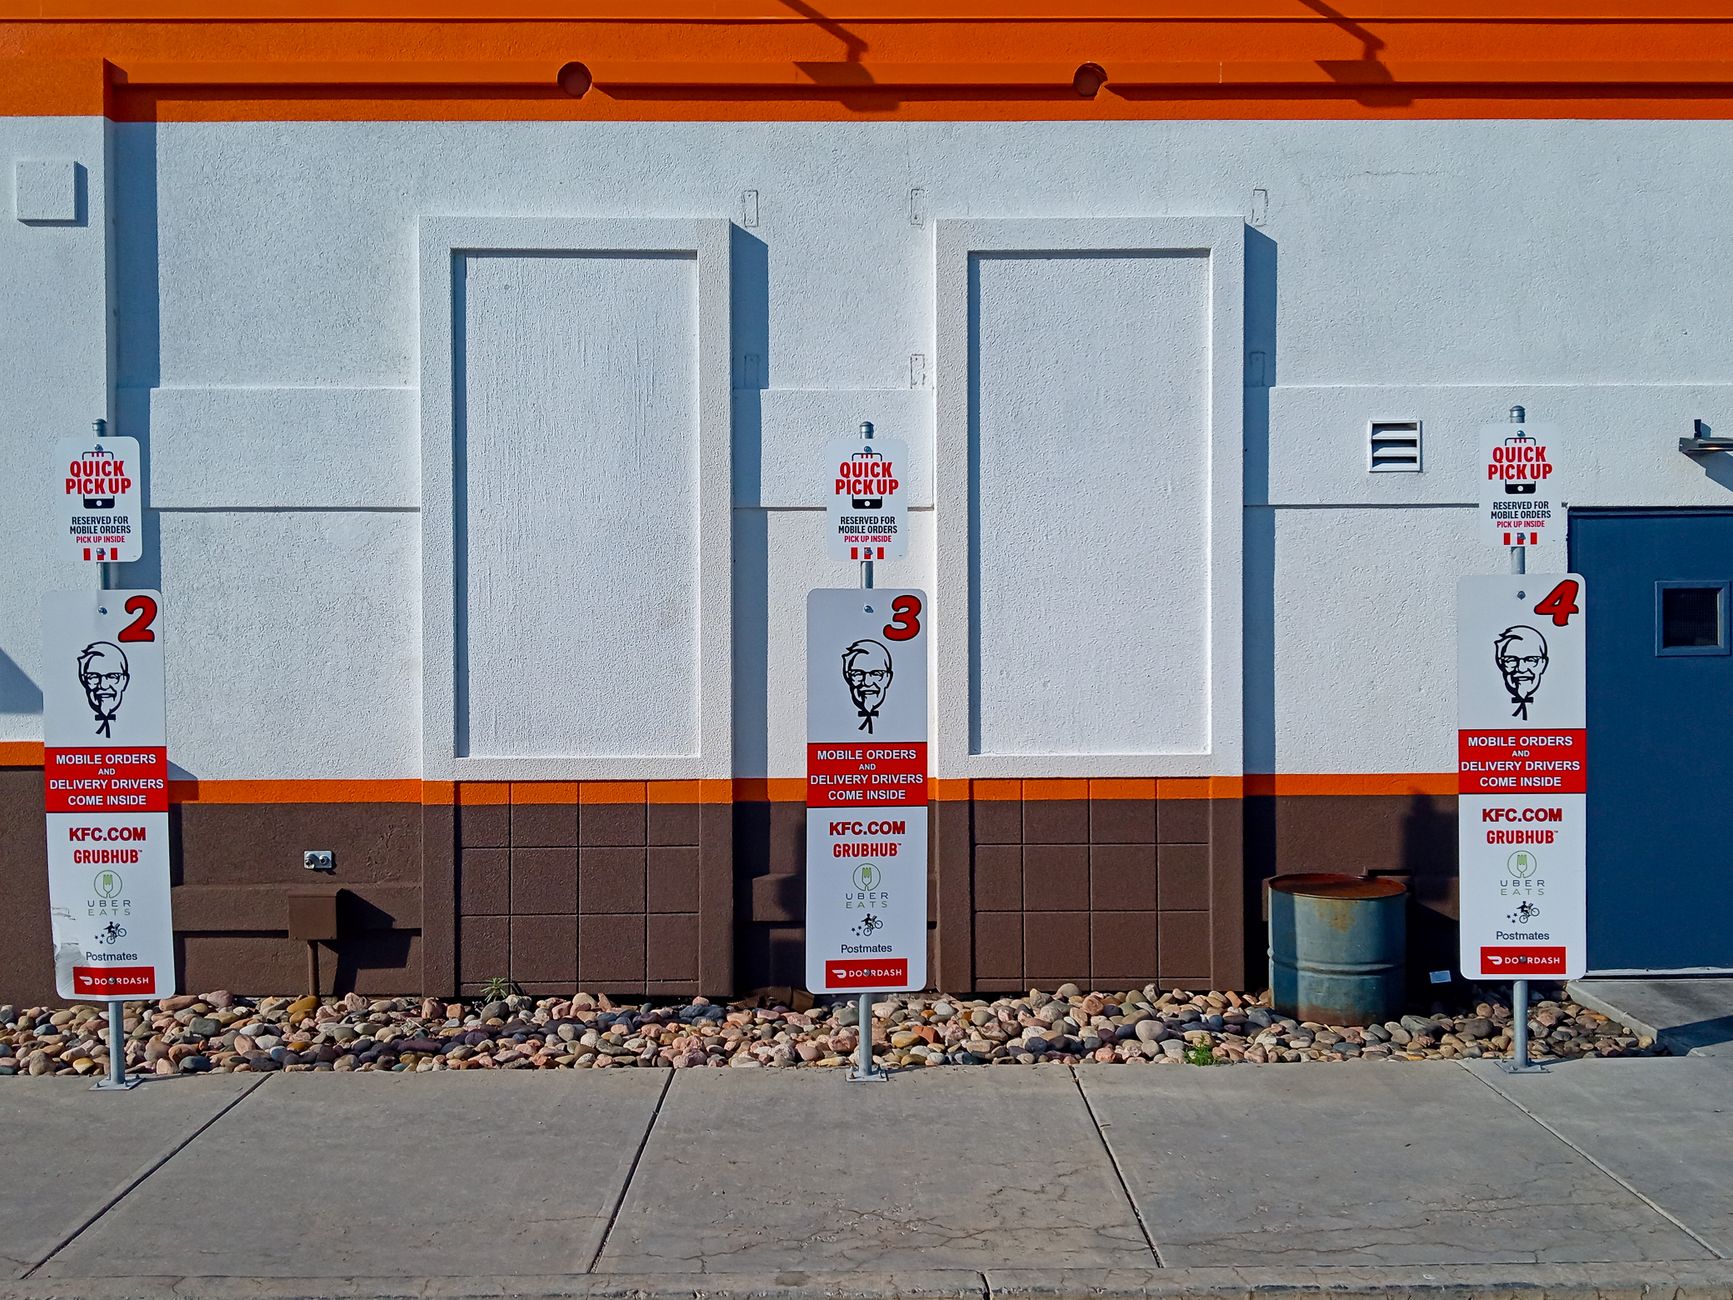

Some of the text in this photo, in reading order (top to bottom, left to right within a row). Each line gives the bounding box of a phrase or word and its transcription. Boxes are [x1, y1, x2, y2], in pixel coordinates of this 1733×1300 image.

[1493, 446, 1546, 463] QUICK
[70, 460, 124, 477] QUICK
[840, 462, 892, 478] QUICK
[1488, 464, 1553, 480] PICK UP
[65, 478, 131, 494] PICK UP
[835, 479, 899, 495] PICK UP
[1493, 501, 1549, 510] RESERVED FOR
[881, 516, 895, 524] FOR
[1491, 511, 1518, 519] MOBILE
[72, 516, 128, 525] RESERVED FOR
[70, 526, 98, 534] MOBILE
[1534, 579, 1579, 627] 4
[118, 595, 158, 642] 2
[883, 594, 922, 641] 3
[1468, 736, 1573, 747] MOBILE ORDERS
[56, 754, 156, 764] MOBILE ORDERS
[817, 750, 916, 760] MOBILE ORDERS
[1461, 761, 1580, 771] DELIVERY DRIVERS
[50, 779, 164, 789] DELIVERY DRIVERS
[810, 774, 923, 785] DELIVERY DRIVERS
[1480, 777, 1562, 787] COME INSIDE
[828, 790, 906, 800] COME INSIDE
[68, 795, 146, 806] COME INSIDE
[1482, 808, 1562, 822] KFC.COM
[829, 821, 905, 835] KFC.COM
[69, 827, 146, 841] KFC.COM
[846, 892, 888, 900] UBER
[1496, 931, 1550, 940] Postmates
[841, 945, 892, 953] Postmates
[86, 952, 138, 961] Postmates
[849, 969, 902, 977] DORDASH
[94, 977, 149, 985] DORDASH
